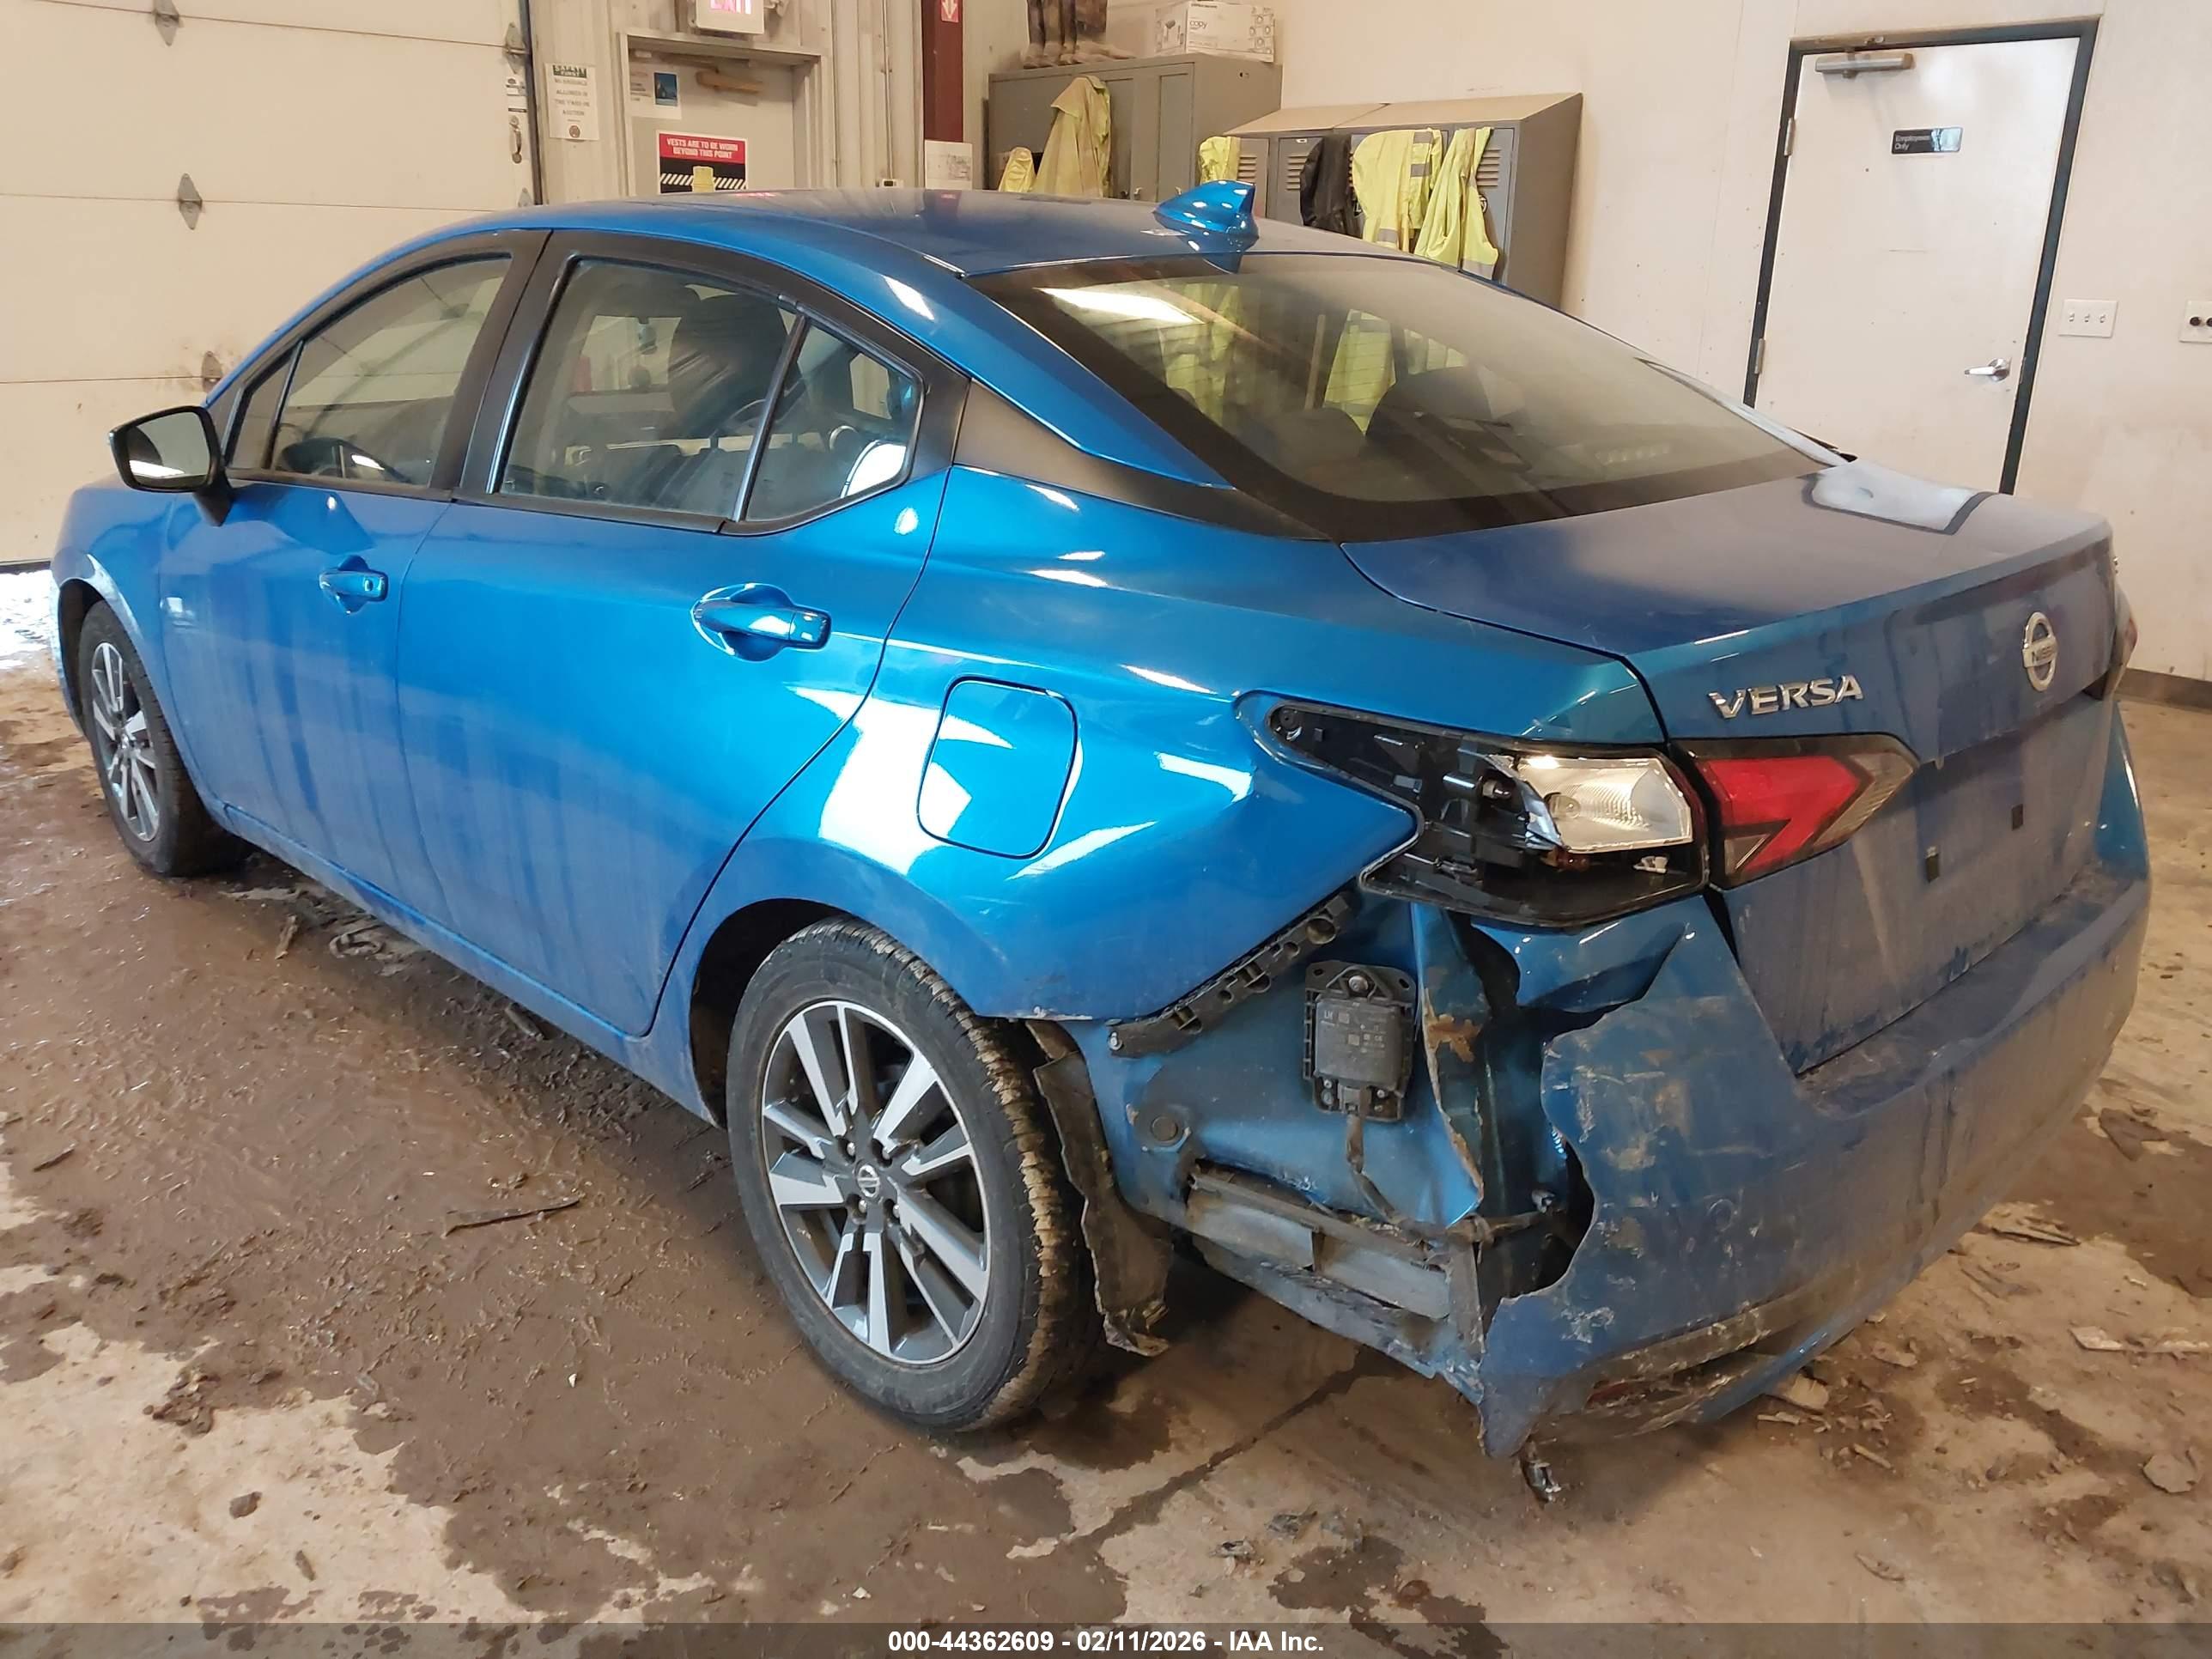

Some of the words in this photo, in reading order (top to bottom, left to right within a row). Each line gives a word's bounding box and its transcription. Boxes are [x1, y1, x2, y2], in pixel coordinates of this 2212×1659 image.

[666, 138, 686, 147] VESTS
[719, 143, 738, 152] WORN
[672, 146, 698, 156] BEYOND
[714, 150, 732, 159] POINT
[1708, 675, 1863, 719] VERSA
